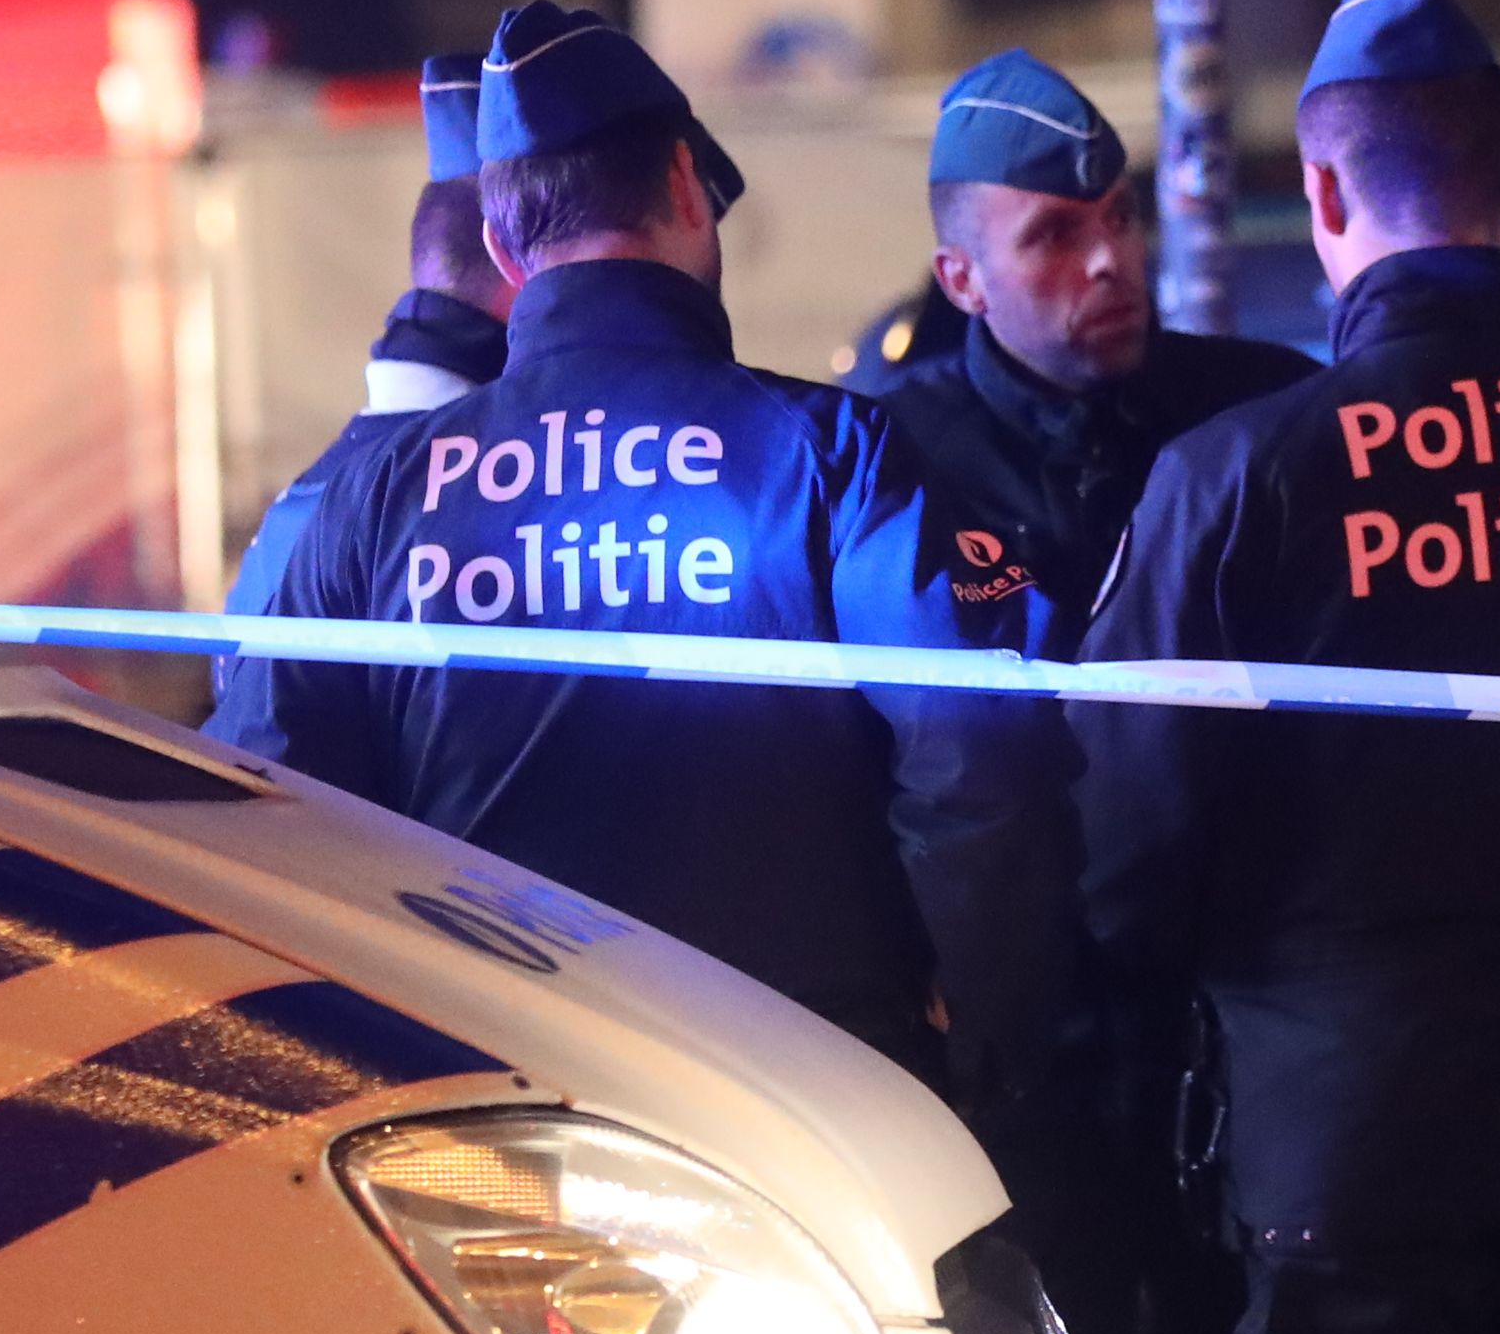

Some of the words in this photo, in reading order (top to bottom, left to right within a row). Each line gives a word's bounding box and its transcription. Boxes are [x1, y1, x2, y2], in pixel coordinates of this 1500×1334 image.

[422, 408, 725, 513] Police
[406, 513, 735, 624] Politie
[952, 577, 1010, 603] Police
